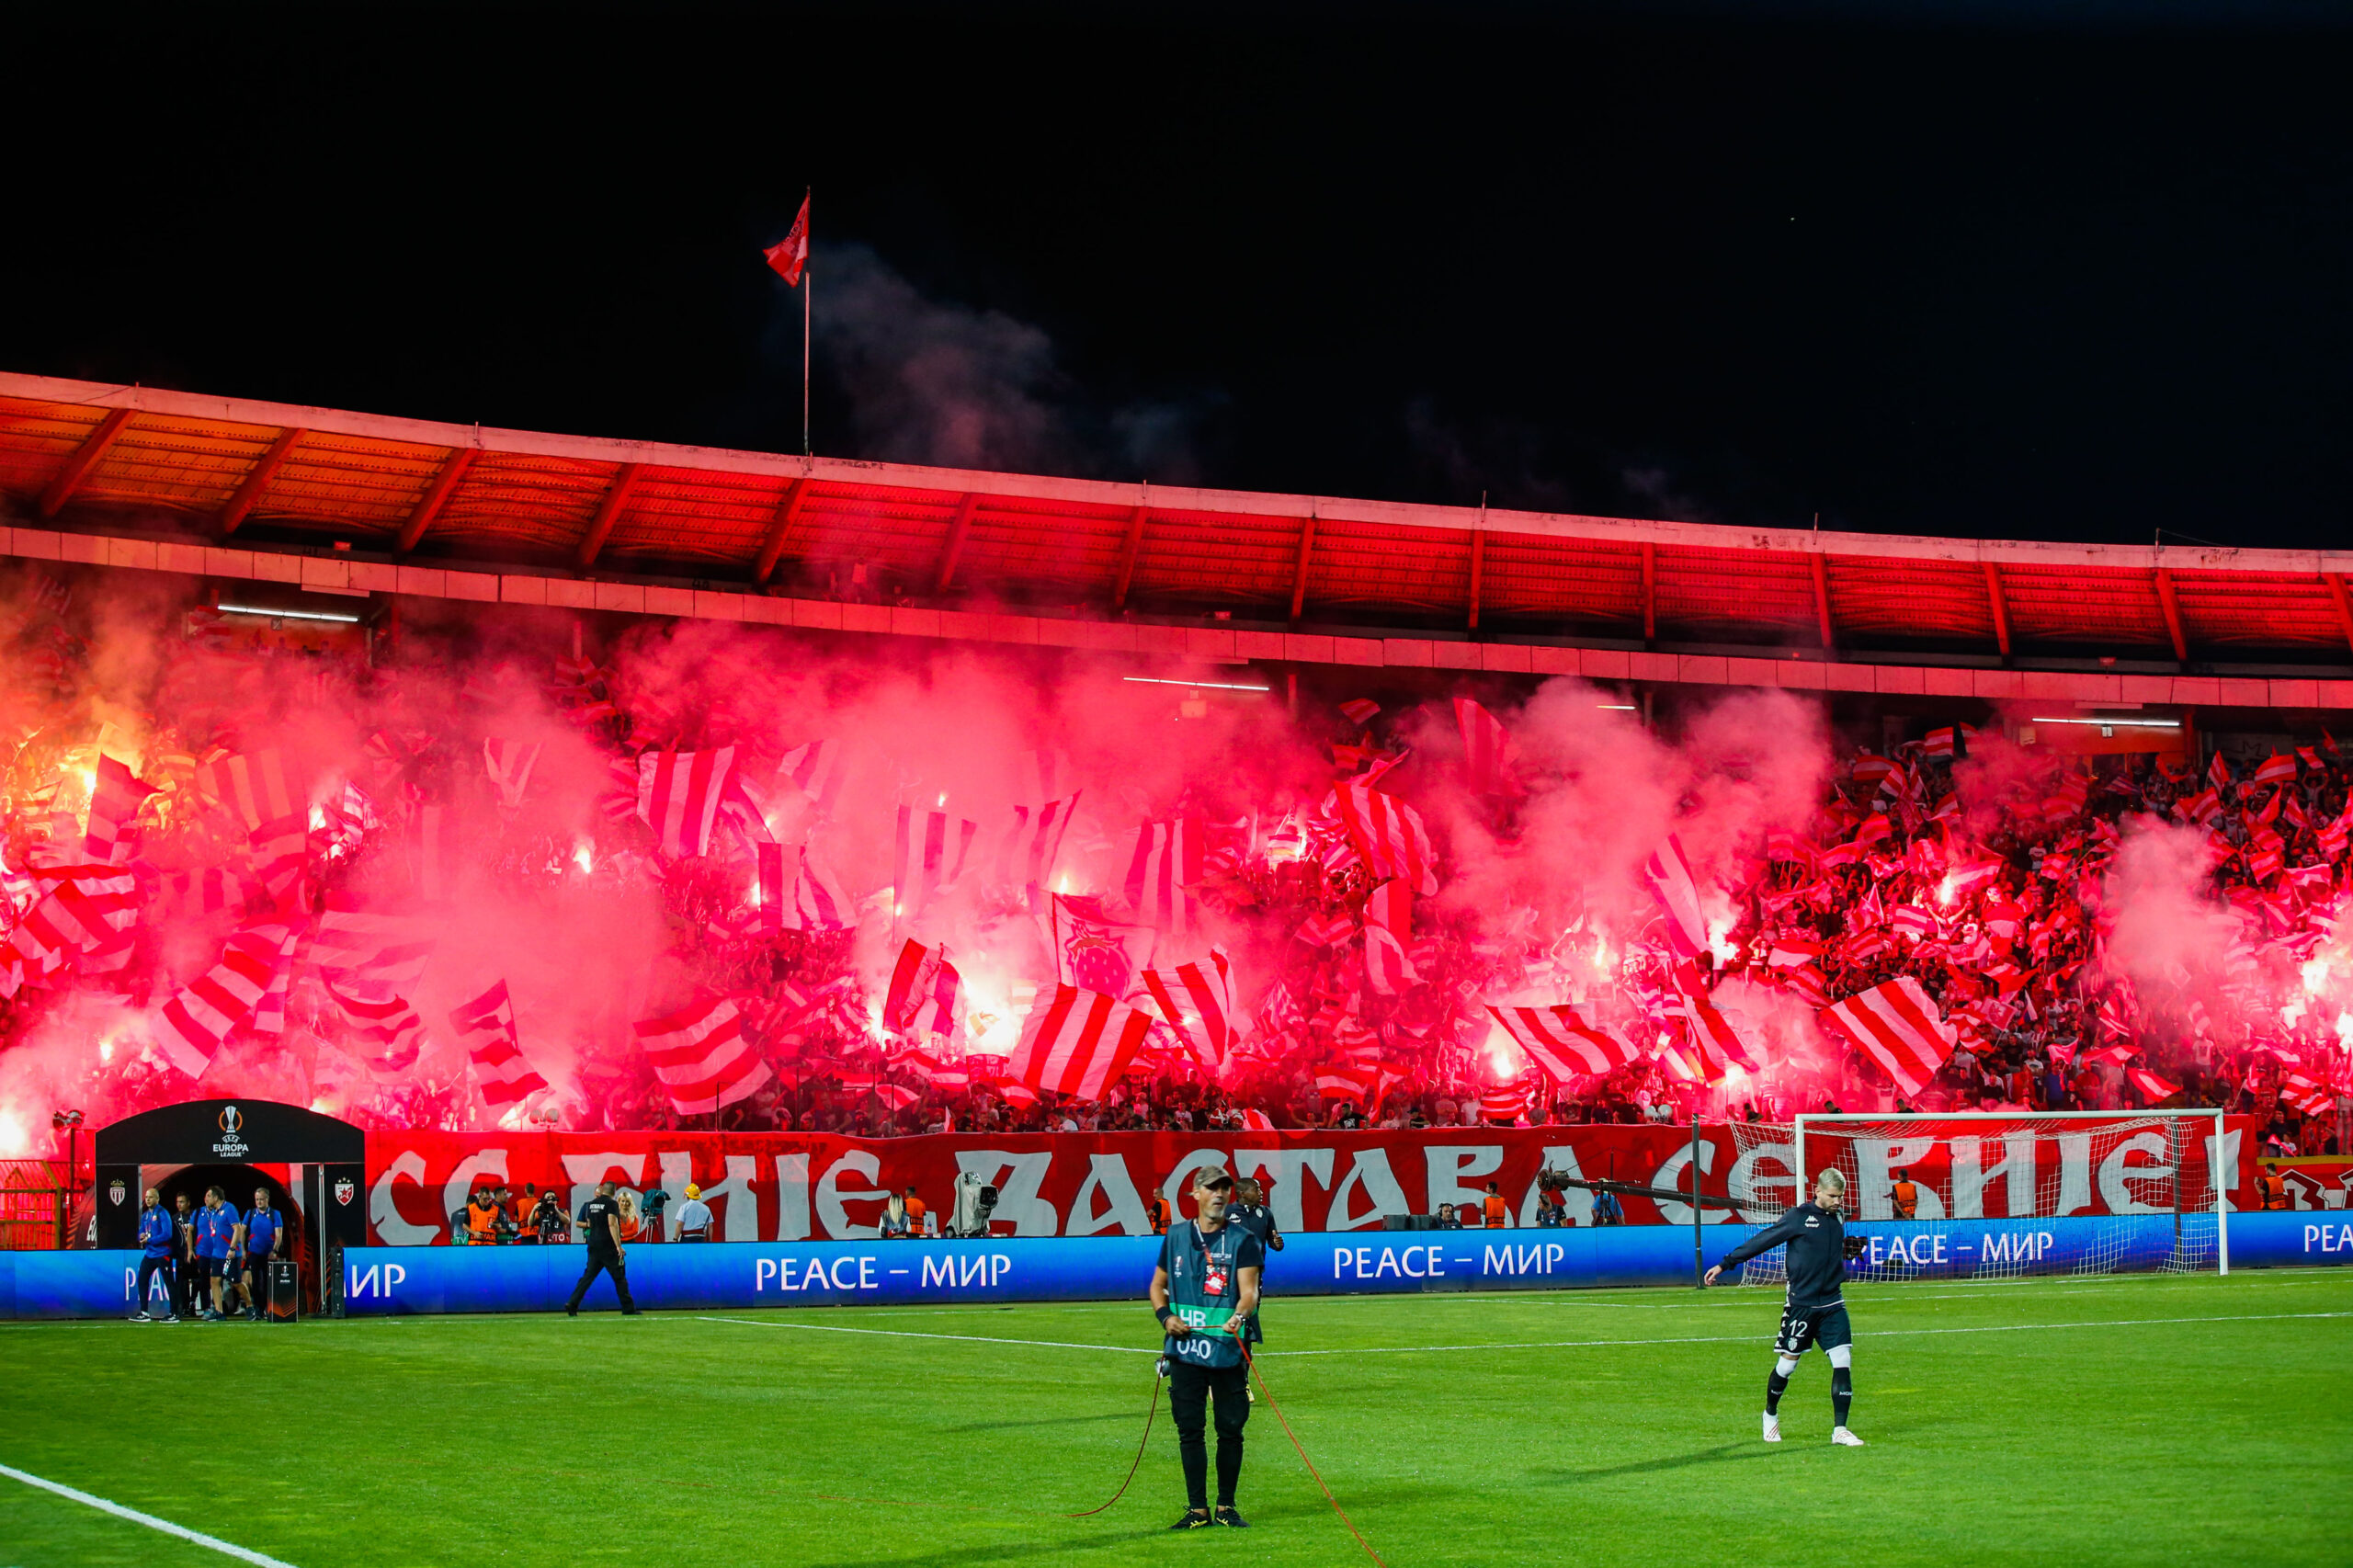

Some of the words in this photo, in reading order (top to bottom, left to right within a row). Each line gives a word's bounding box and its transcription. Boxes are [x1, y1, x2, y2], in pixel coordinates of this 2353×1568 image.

[212, 1143, 249, 1153] EUROPA
[222, 1134, 241, 1143] UEFA
[455, 1235, 467, 1244] TV
[1851, 1234, 1949, 1267] EACE
[1982, 1232, 2054, 1263] МИР
[756, 1256, 879, 1291] PEACE
[921, 1254, 1011, 1289] МИР
[1334, 1245, 1446, 1279] PEACE
[1483, 1244, 1564, 1276] МИР
[343, 1264, 406, 1299] ИР
[1789, 1320, 1808, 1338] 12
